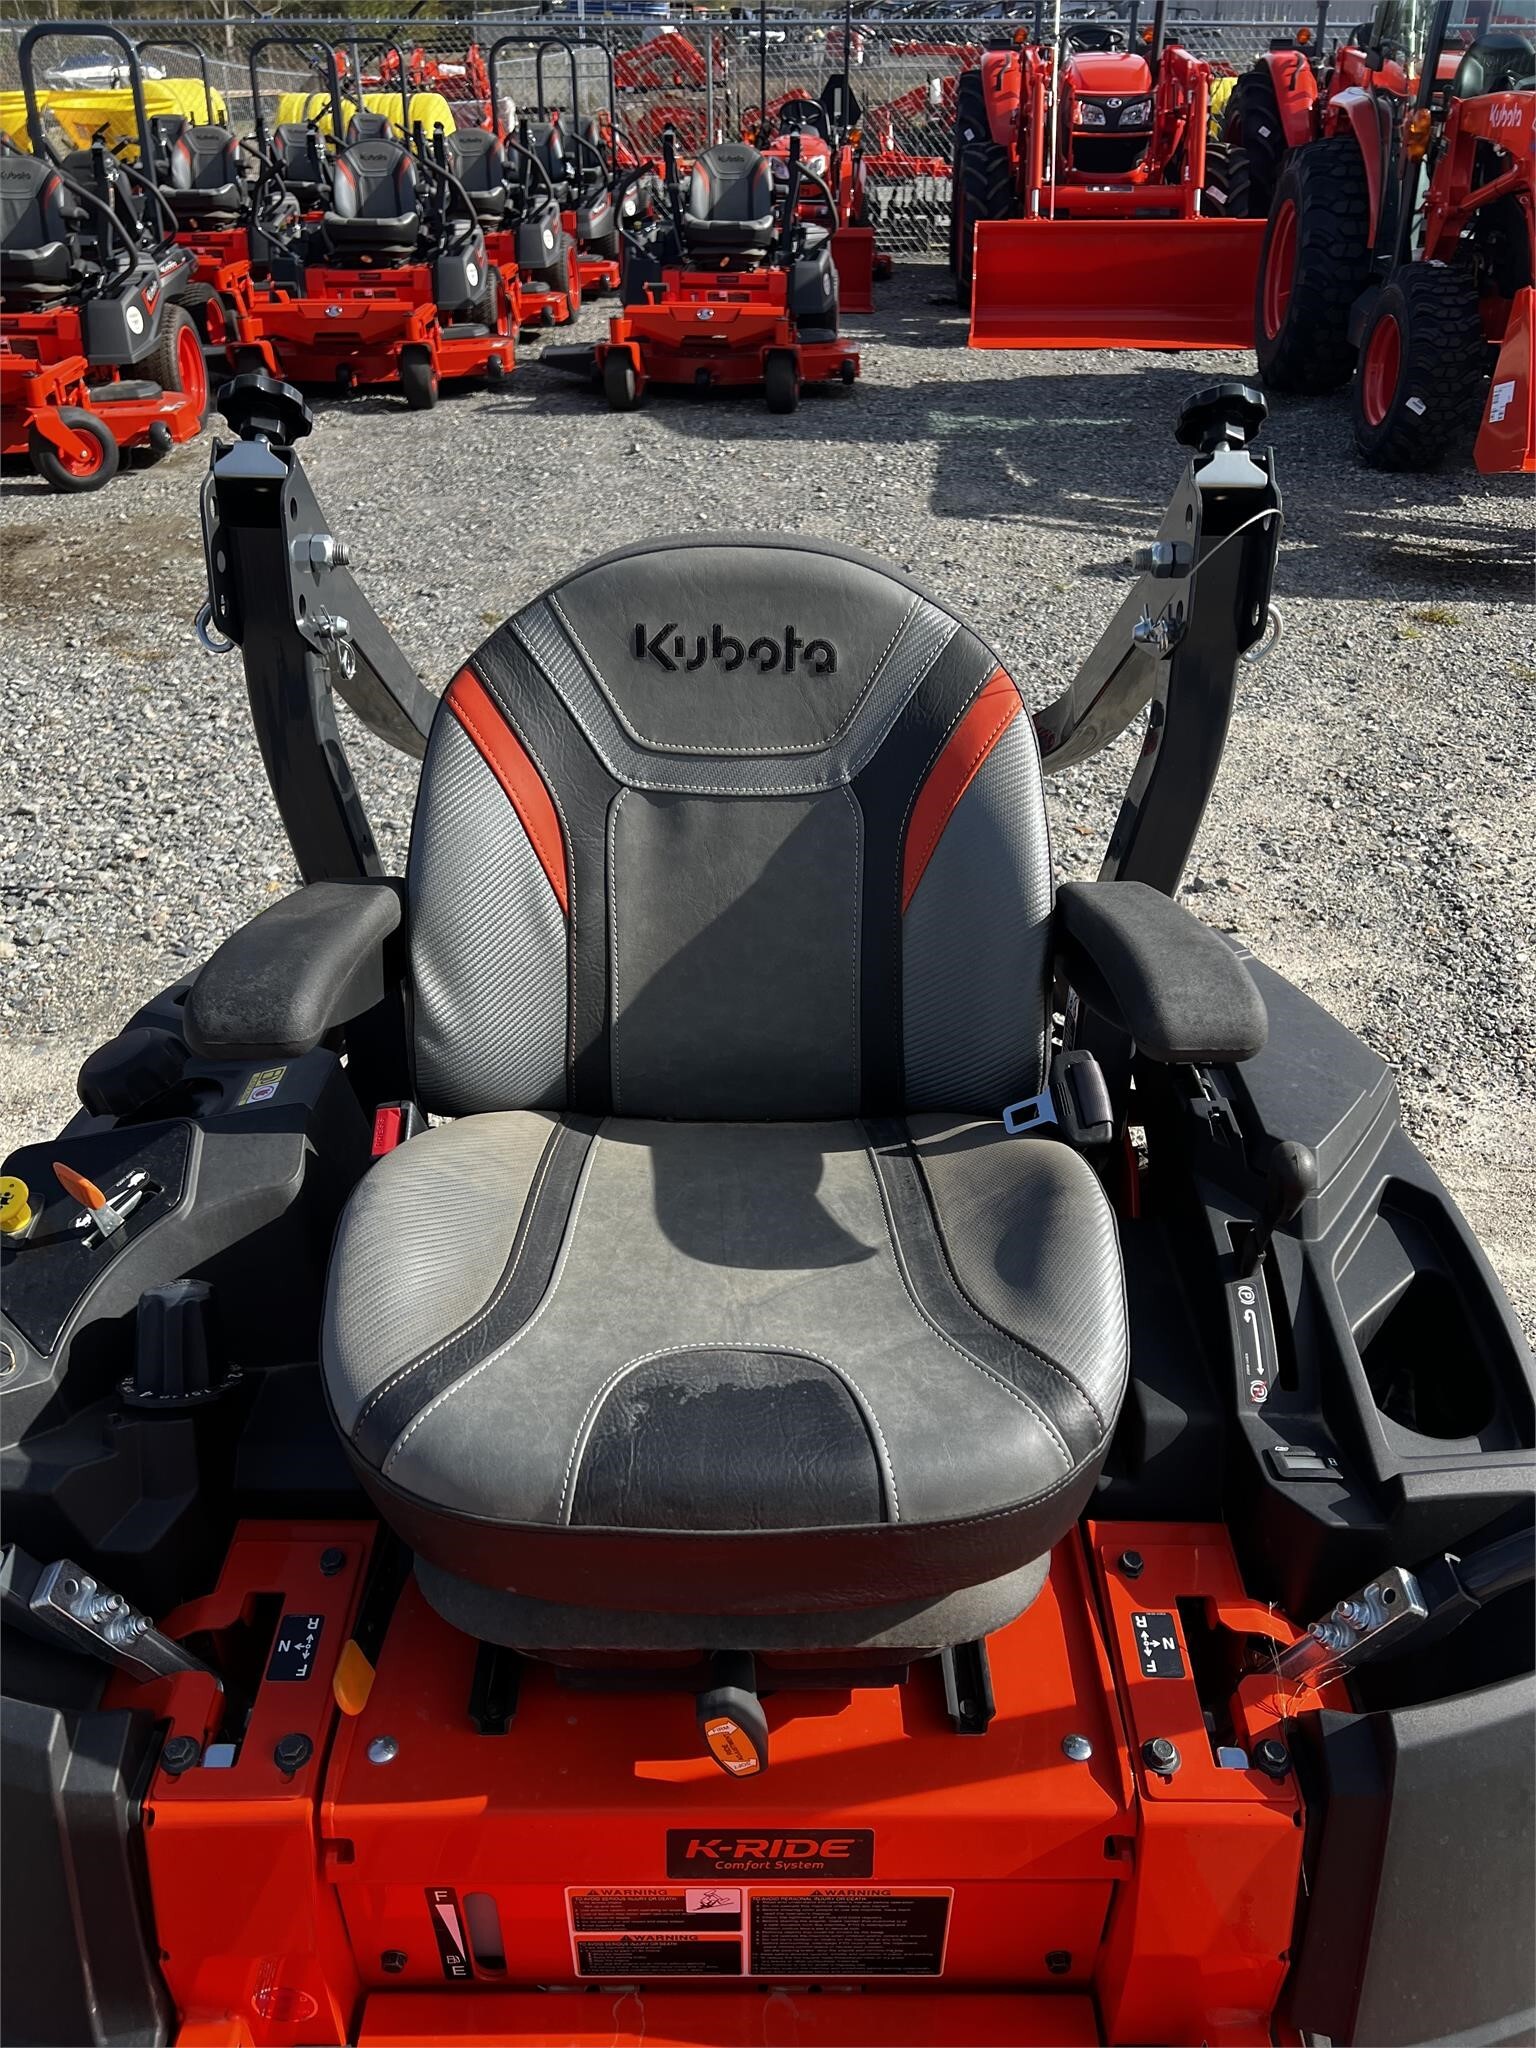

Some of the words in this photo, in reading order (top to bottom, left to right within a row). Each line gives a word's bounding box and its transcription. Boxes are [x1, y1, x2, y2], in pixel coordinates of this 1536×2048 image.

[1489, 102, 1522, 127] Kubota
[634, 623, 838, 674] Kubota
[374, 1118, 385, 1147] PRESS
[307, 1617, 320, 1630] R
[1135, 1615, 1148, 1628] R
[278, 1640, 291, 1652] N
[1162, 1637, 1175, 1650] N
[295, 1664, 307, 1677] F
[1146, 1659, 1157, 1673] F
[685, 1839, 856, 1858] K-RIDE
[715, 1860, 770, 1871] Comfort
[774, 1860, 824, 1871] System
[434, 1890, 448, 1902] F
[452, 1965, 466, 1976] E
